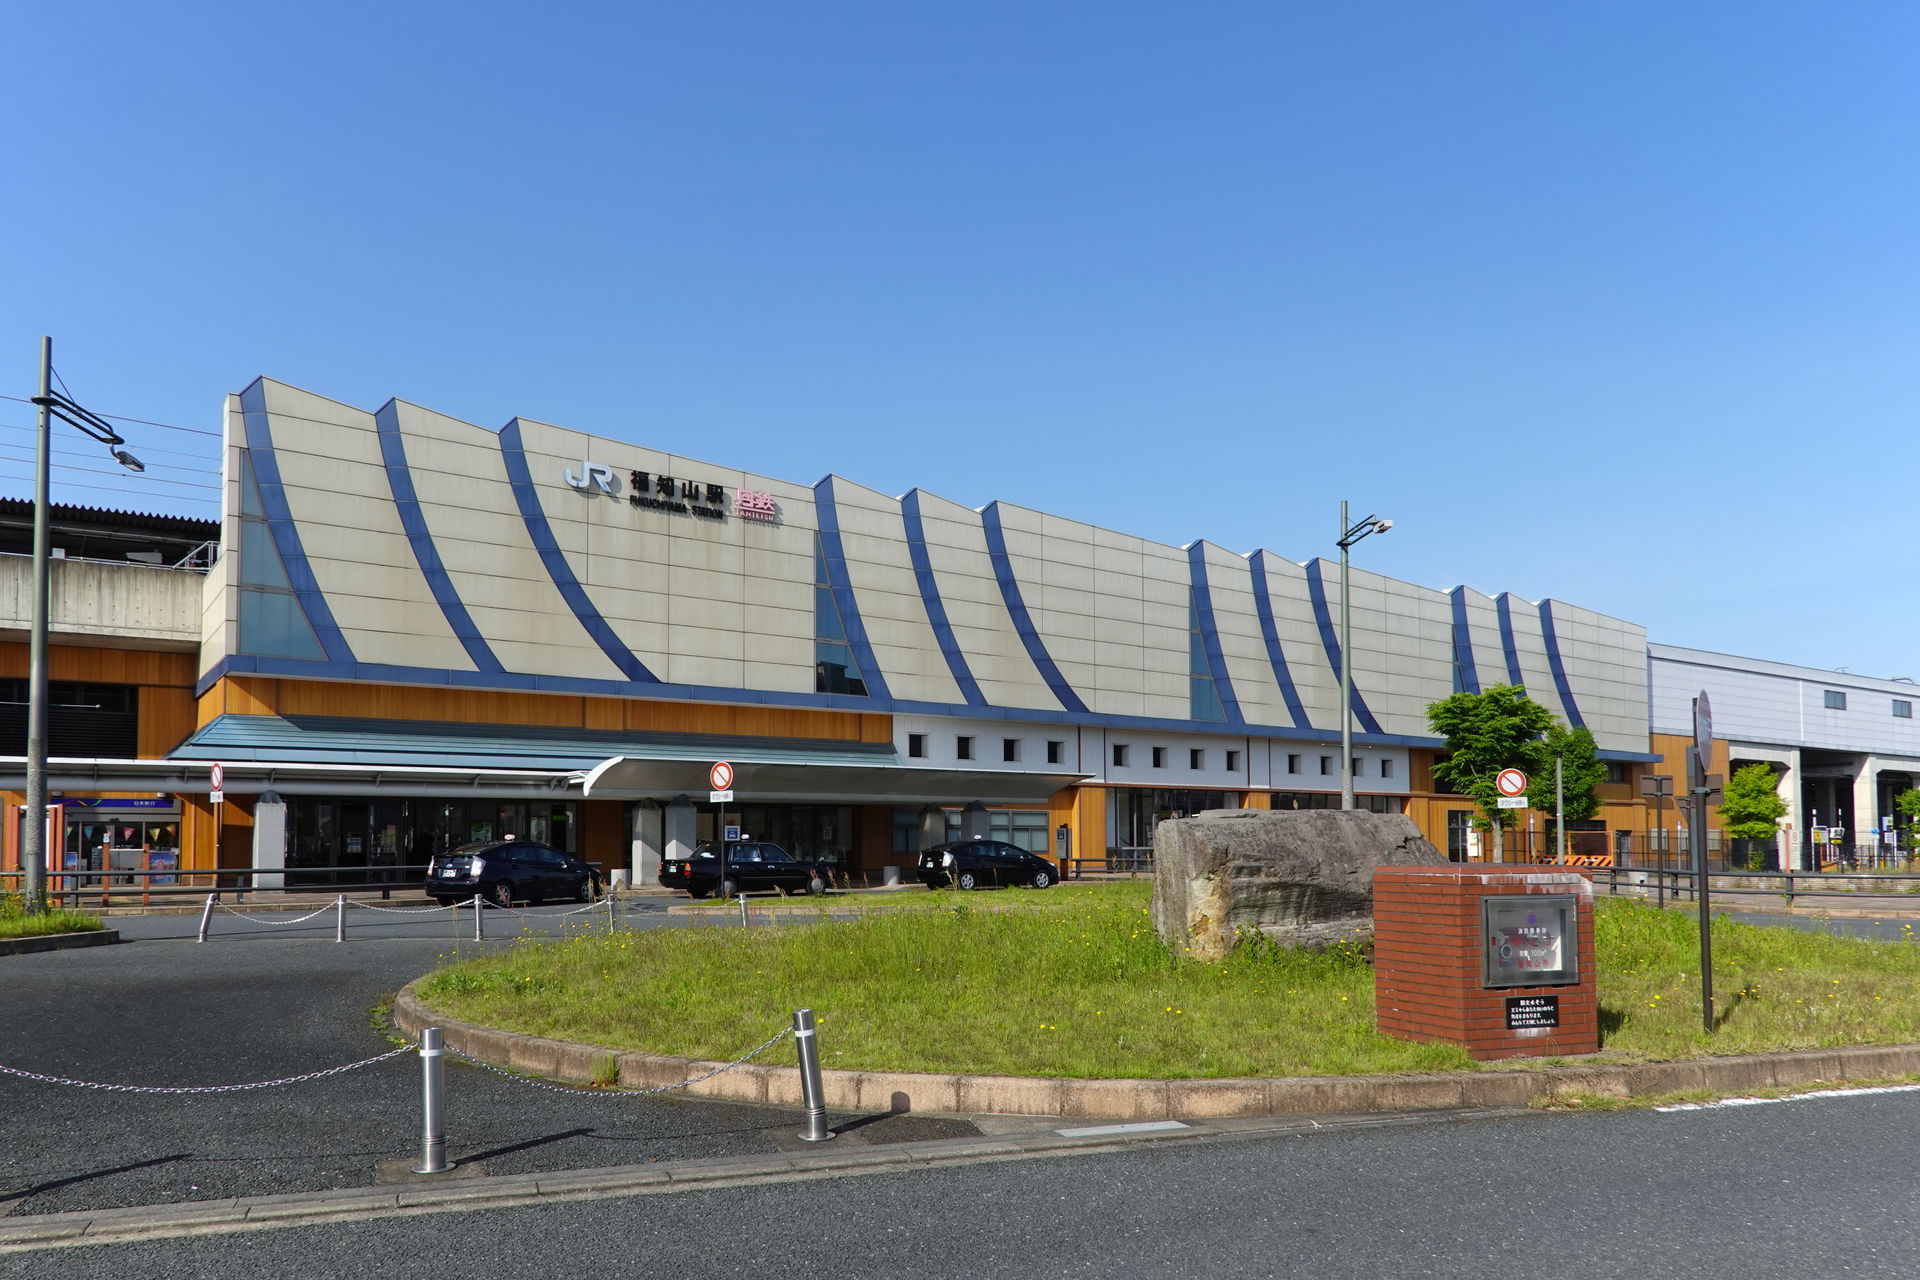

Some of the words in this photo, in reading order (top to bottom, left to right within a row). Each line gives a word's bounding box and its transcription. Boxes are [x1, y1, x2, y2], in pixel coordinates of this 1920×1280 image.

[563, 461, 613, 493] JR
[630, 470, 724, 505] 福知山駅
[629, 494, 687, 514] FUKUCHIYAMA
[692, 505, 724, 520] STATION
